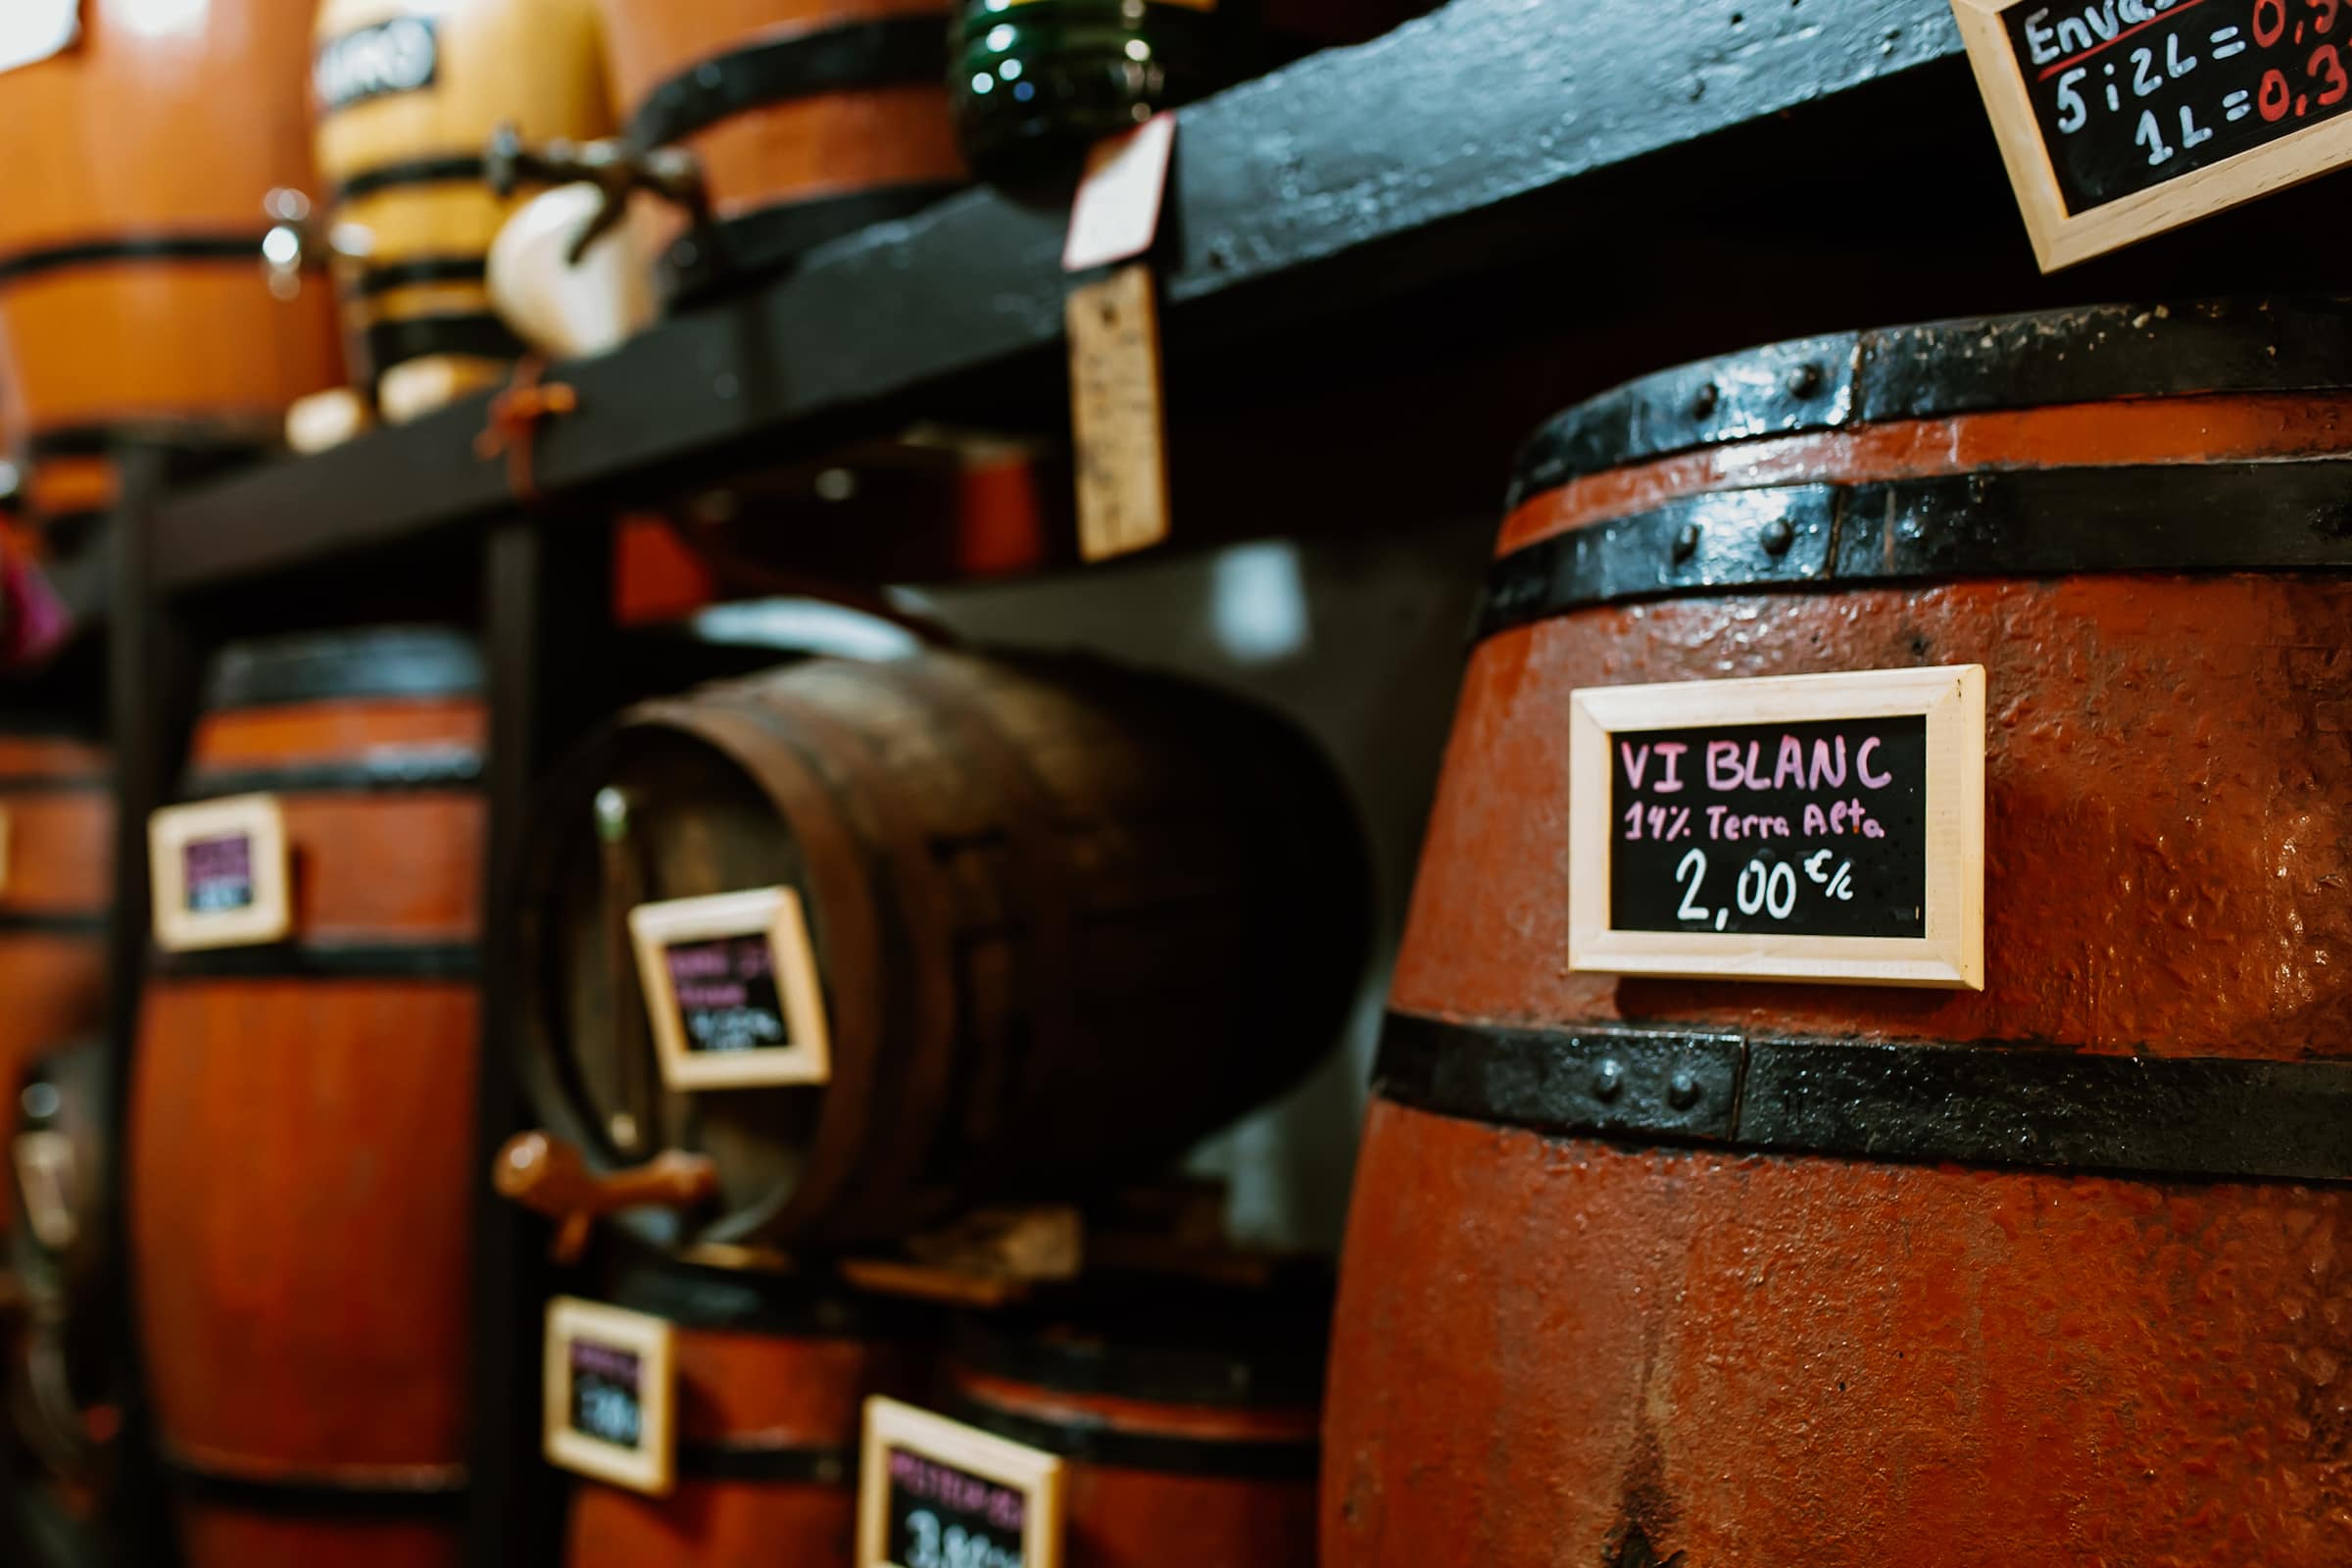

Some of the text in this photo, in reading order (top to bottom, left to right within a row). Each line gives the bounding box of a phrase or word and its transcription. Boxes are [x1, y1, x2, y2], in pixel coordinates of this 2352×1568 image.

[2025, 0, 2178, 65] Enva
[2058, 68, 2086, 133] 5
[2134, 105, 2213, 166] 1L
[2258, 39, 2352, 122] 0,3
[1621, 734, 1892, 793] VI BLANC
[1624, 797, 1886, 842] 14% Terra Alta
[1675, 847, 1797, 932] 2,00
